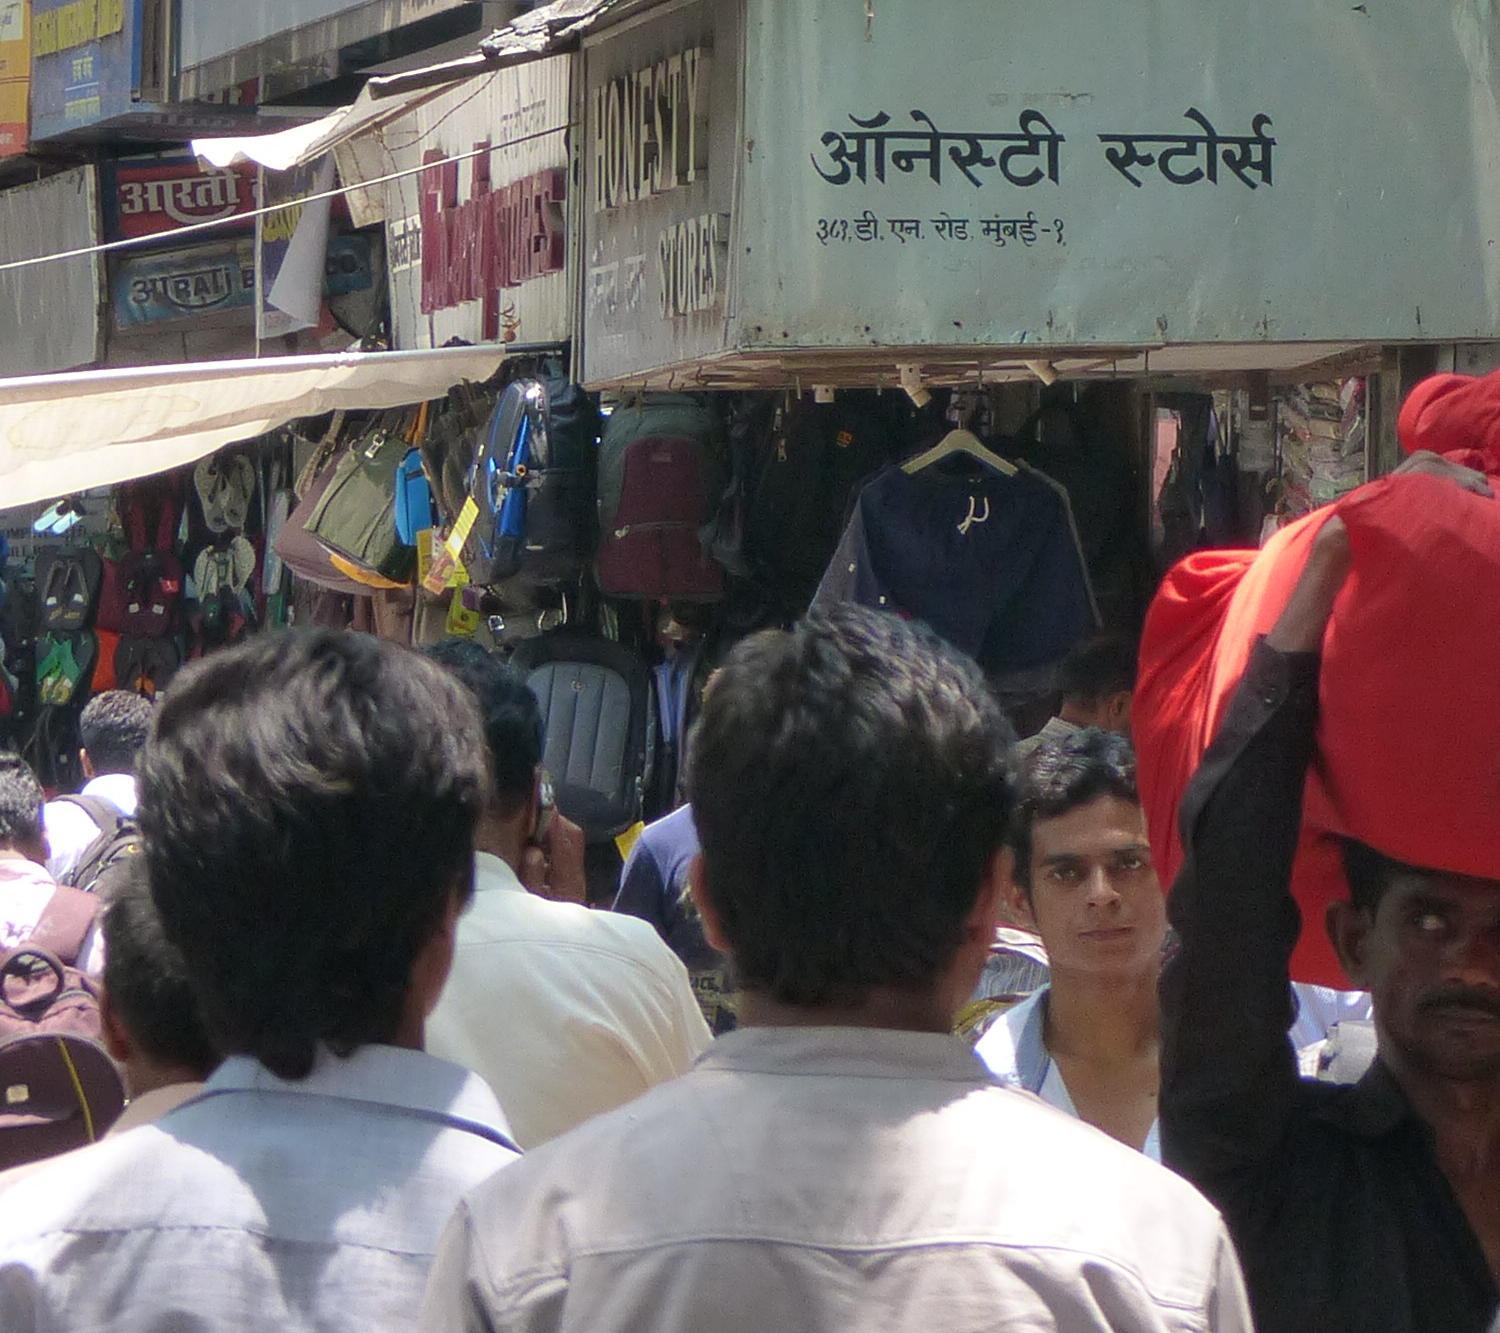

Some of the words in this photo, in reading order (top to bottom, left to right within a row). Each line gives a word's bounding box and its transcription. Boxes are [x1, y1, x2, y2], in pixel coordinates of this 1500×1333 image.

[594, 46, 701, 213] HONESTY
[811, 109, 1067, 188] ऑनेस्टी
[1097, 108, 1279, 190] स्टोर्स
[658, 212, 718, 320] STORES
